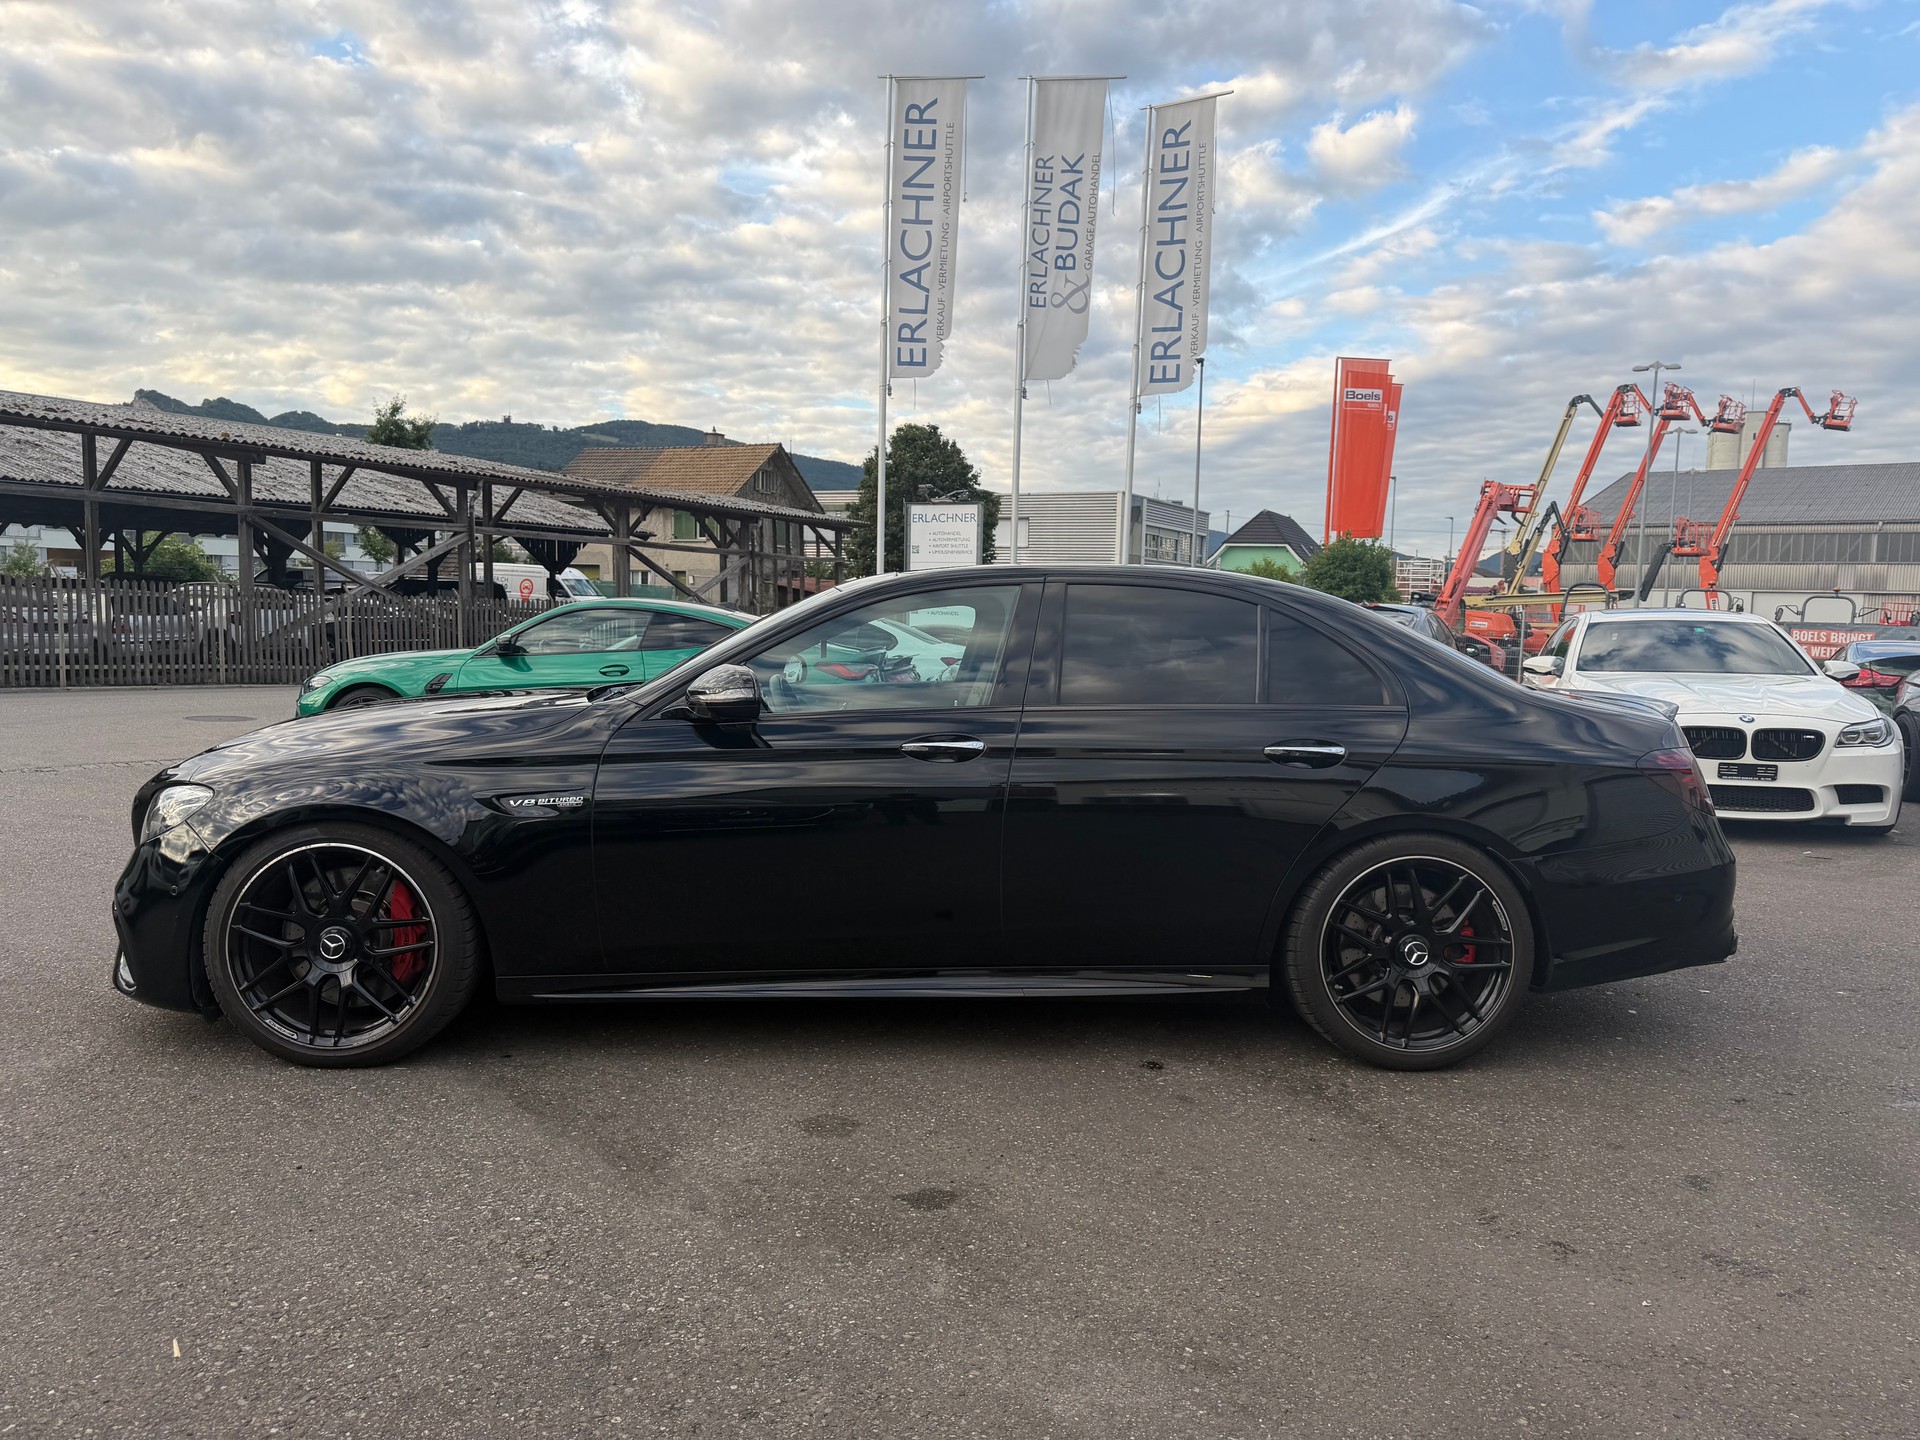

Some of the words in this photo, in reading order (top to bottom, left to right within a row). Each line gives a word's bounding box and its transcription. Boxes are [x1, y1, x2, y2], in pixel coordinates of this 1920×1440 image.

[944, 122, 955, 215] AIRPORTSHUTTLE
[1087, 152, 1101, 226] AUTOHANDEL
[1197, 141, 1207, 233] AIRPORTSHUTTLE
[897, 97, 938, 367] ERLACHNER
[1030, 155, 1054, 308] ERLACHNER
[1054, 152, 1085, 270] BUDAK
[939, 223, 950, 293] VERMIETUNG
[1084, 226, 1094, 271] GARAGE
[1149, 119, 1192, 384] ERLACHNER
[1191, 239, 1203, 309] VERMIETUNG
[937, 298, 946, 343] VERKAUF
[1050, 272, 1090, 314] &
[1190, 312, 1199, 358] VERKAUF
[1345, 390, 1381, 400] Boels
[912, 513, 976, 523] ERLACHNER
[1792, 630, 1827, 642] BOELS
[1830, 632, 1873, 643] BRINGT
[509, 799, 535, 807] V8
[537, 796, 583, 805] BITURBO
